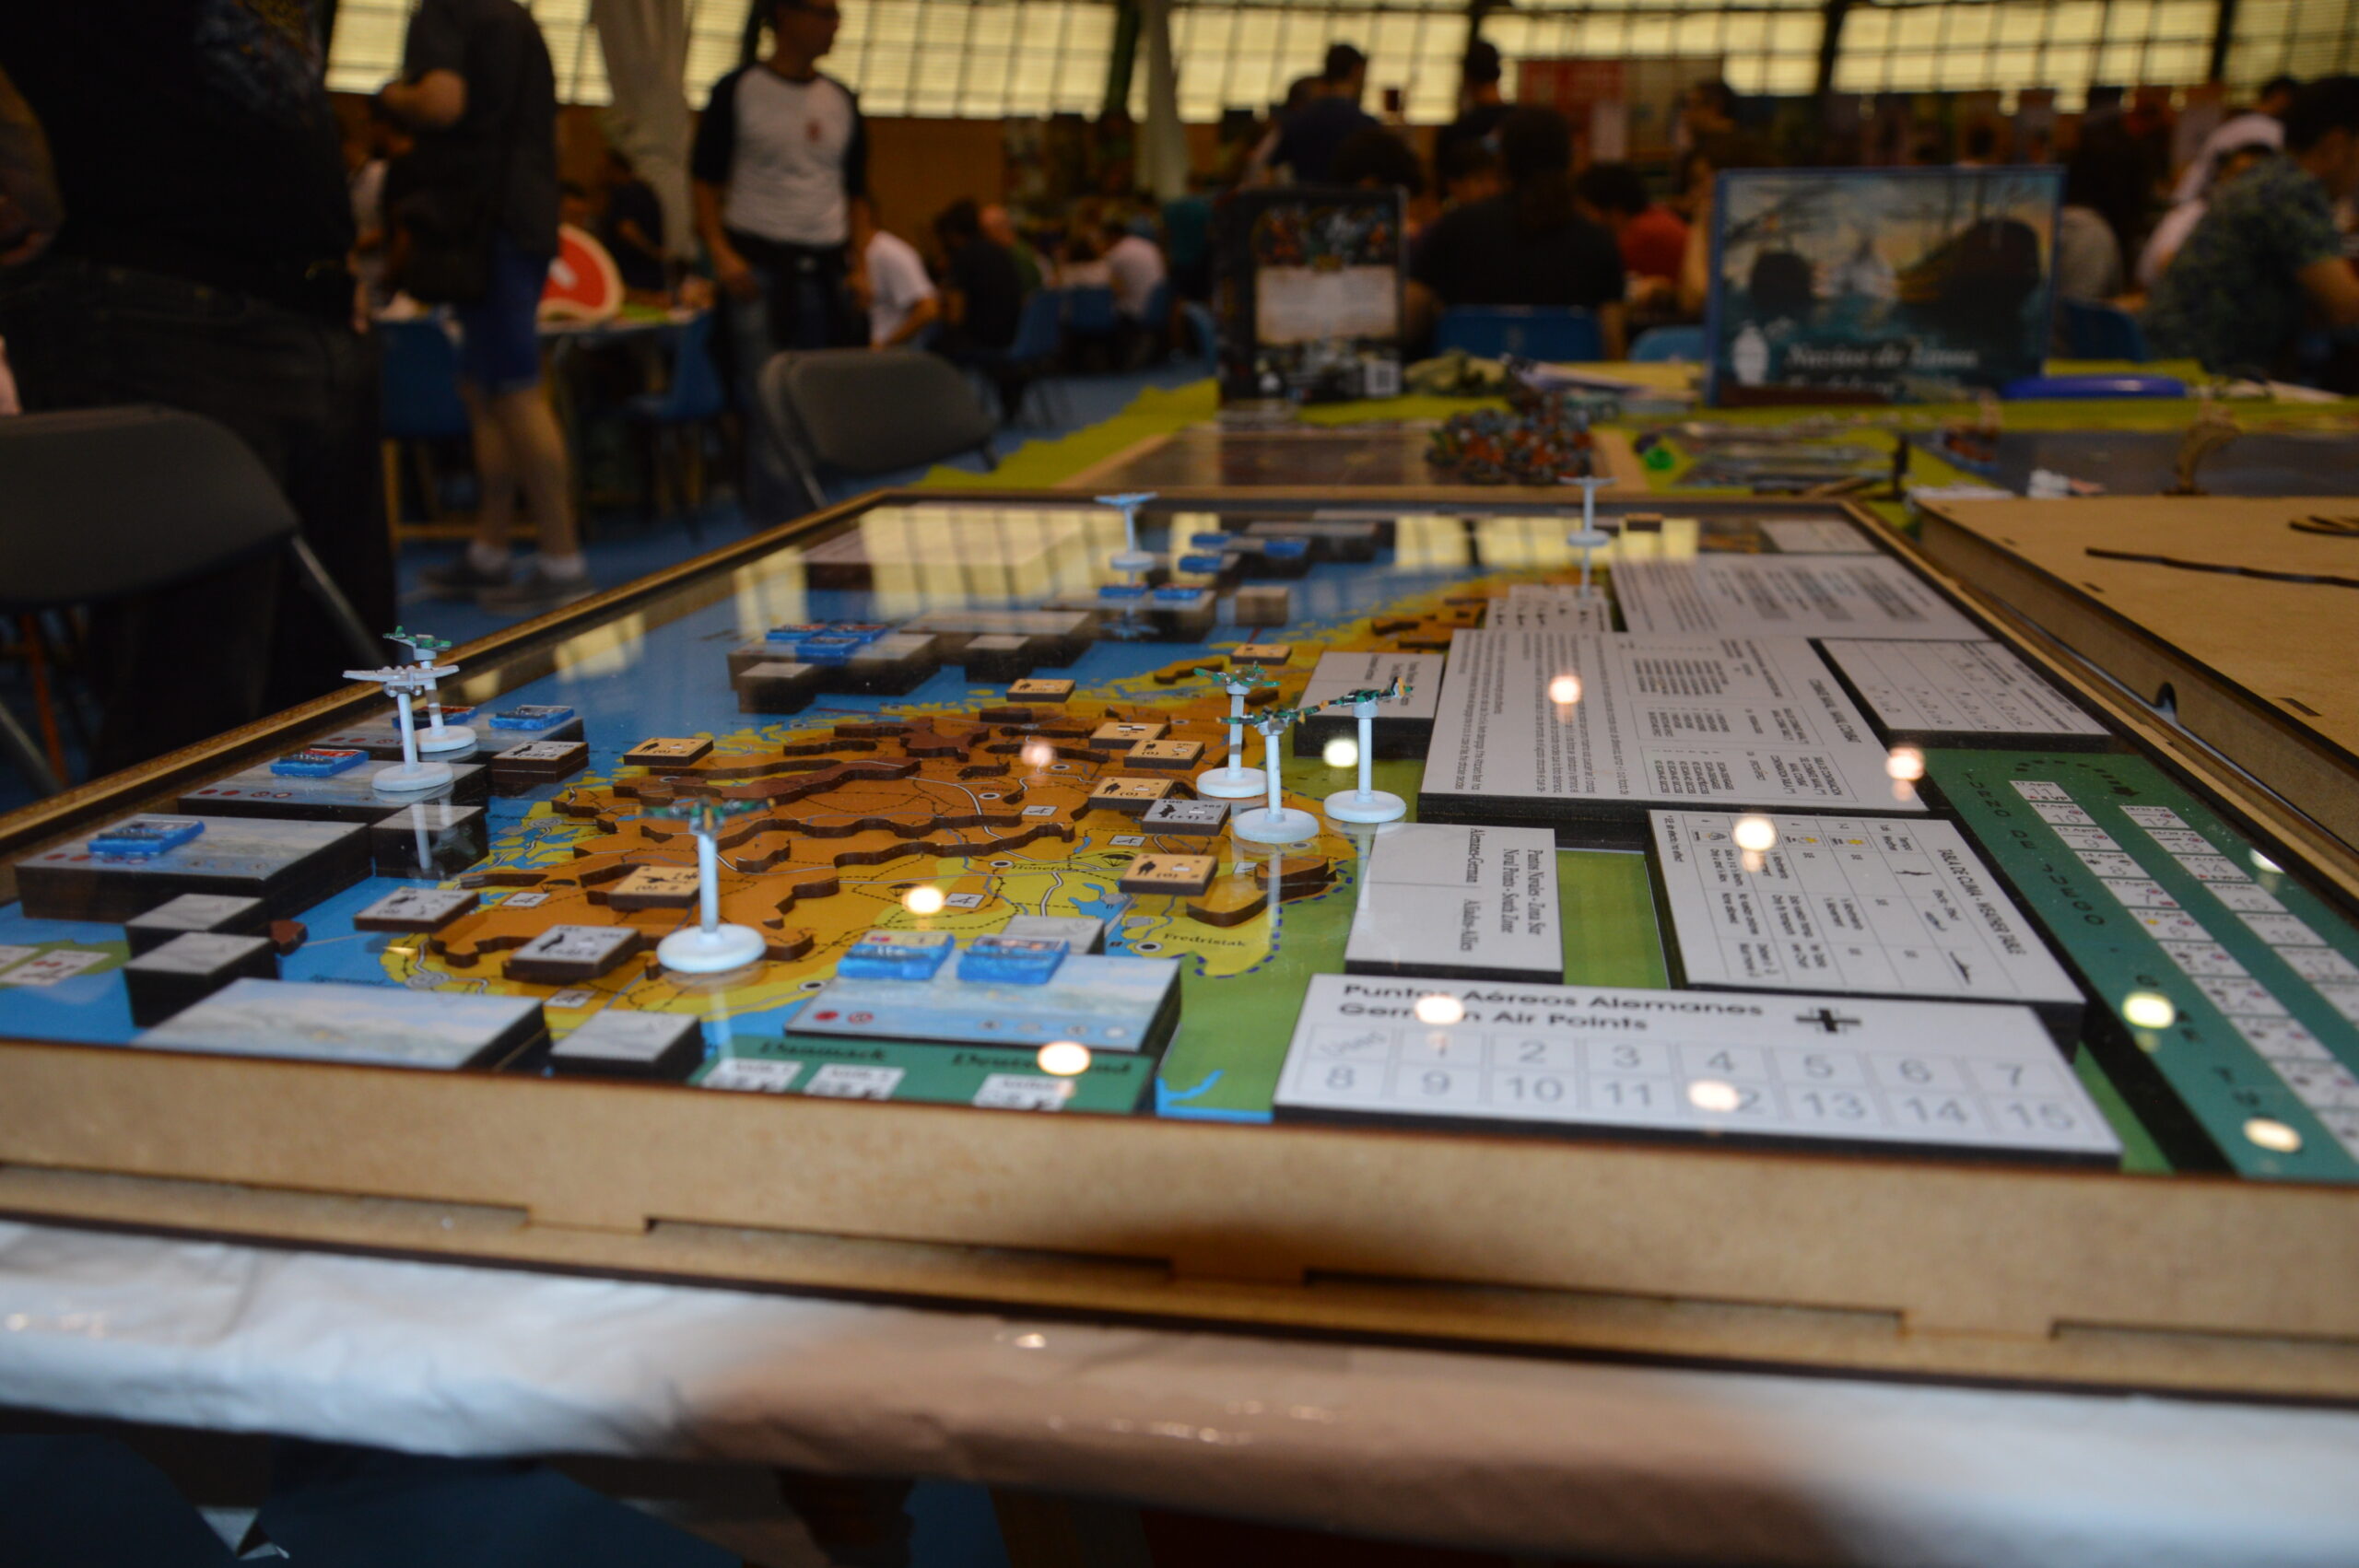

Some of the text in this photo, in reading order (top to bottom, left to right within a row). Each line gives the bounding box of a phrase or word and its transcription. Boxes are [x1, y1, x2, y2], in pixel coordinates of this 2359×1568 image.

[2028, 788, 2052, 796] 11
[2053, 813, 2081, 824] 10
[2144, 817, 2176, 827] 12
[1499, 848, 1519, 933] Naval Points South Zone
[2011, 829, 2037, 850] DE
[2042, 863, 2106, 926] JUEGO
[1527, 848, 1545, 936] Puntos Navales Zona Sur
[1934, 848, 2028, 955] TABLA DE CLIMA WEATHER TABLE
[1343, 983, 1764, 1017] Puntos Aéreos Alemanes
[1492, 1010, 1536, 1024] Air
[1547, 1012, 1649, 1031] Points
[1519, 1039, 1548, 1064] 2
[1612, 1044, 1643, 1071] 3
[1706, 1047, 1738, 1076] 4
[1325, 1065, 1355, 1091] 8
[1804, 1053, 1836, 1080] 5
[1900, 1058, 1932, 1085] 6
[2002, 1061, 2033, 1089] 7
[1421, 1071, 1451, 1096] 9
[1507, 1075, 1565, 1104] 10
[1610, 1079, 1654, 1109] 11
[1802, 1089, 1867, 1122] 13
[1905, 1094, 1971, 1129] 14
[2009, 1101, 2075, 1135] 15
